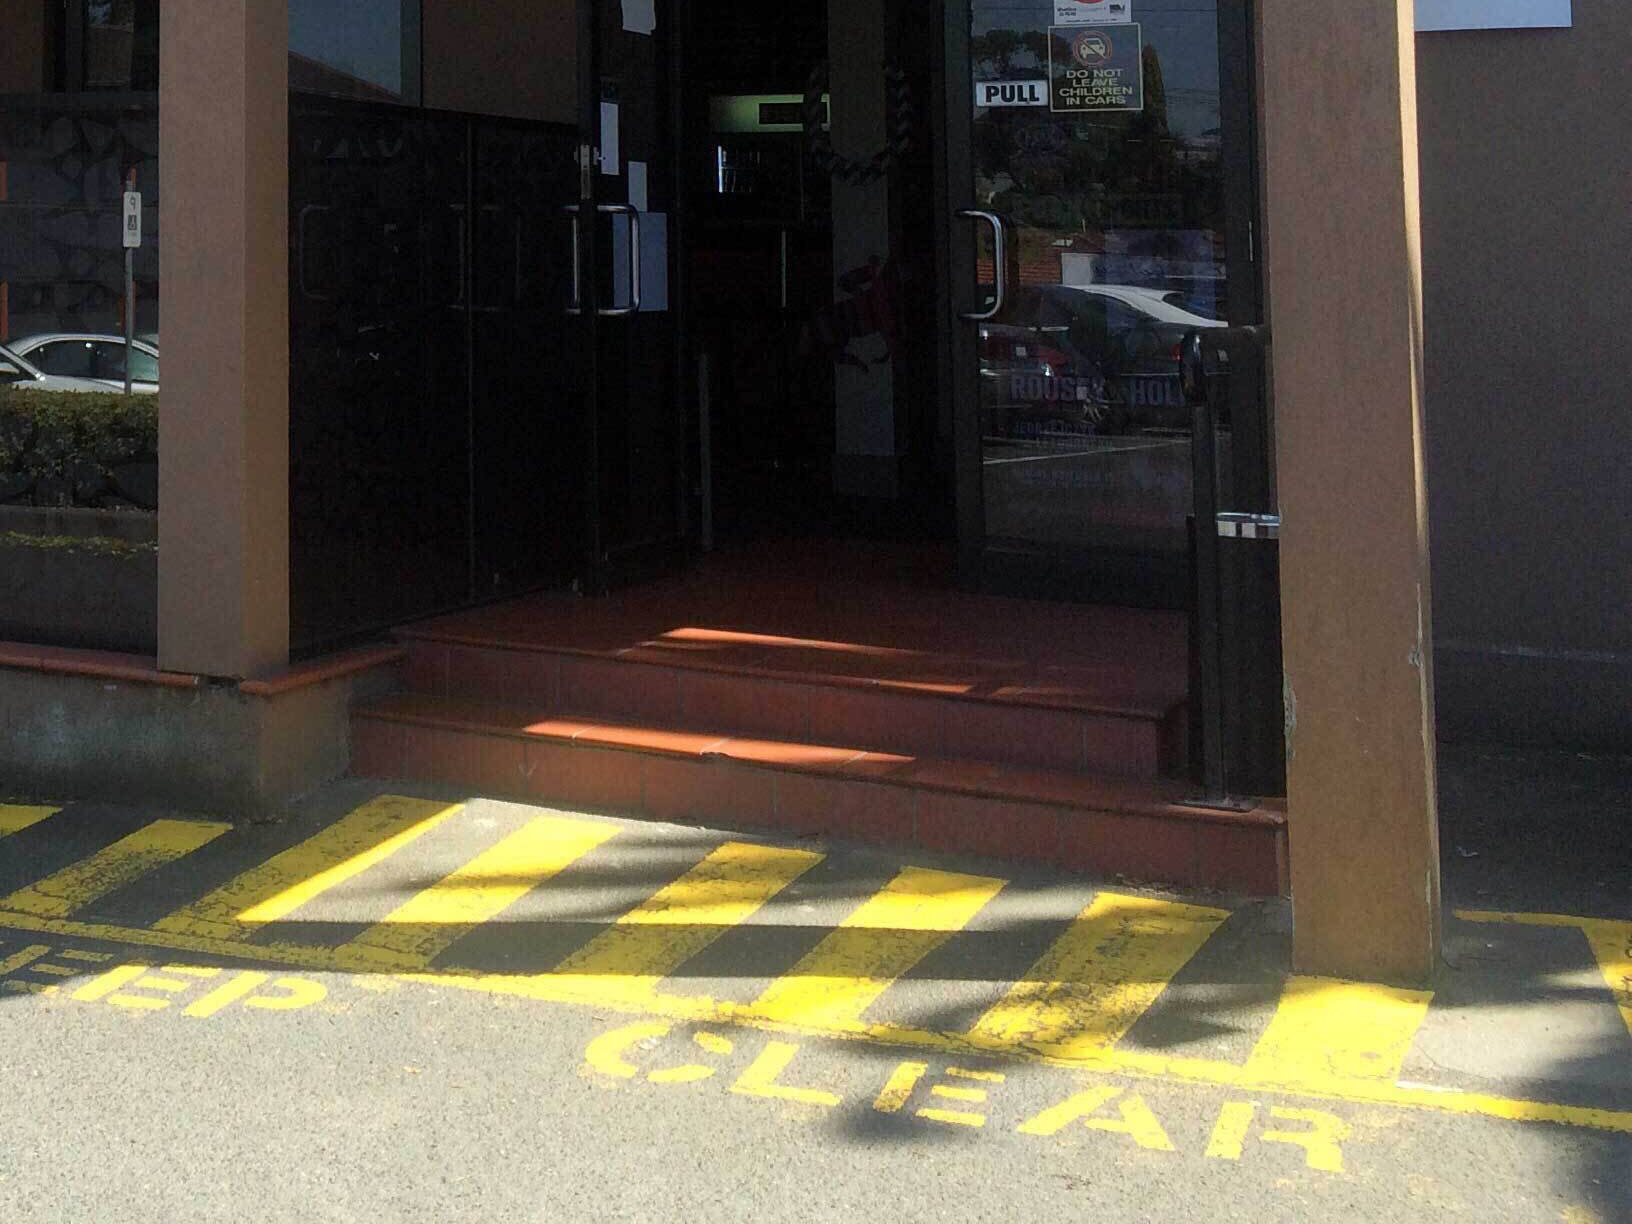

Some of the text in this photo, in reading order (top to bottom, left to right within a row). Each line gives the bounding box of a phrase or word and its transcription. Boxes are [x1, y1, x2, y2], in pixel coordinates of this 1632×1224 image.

[1066, 69, 1123, 79] DO NOT
[1073, 78, 1119, 88] LEAVE
[985, 85, 1040, 103] PULL
[1059, 87, 1133, 96] CHILDREN
[1066, 95, 1126, 105] IN CARS
[580, 1020, 1354, 1173] CLEAR
